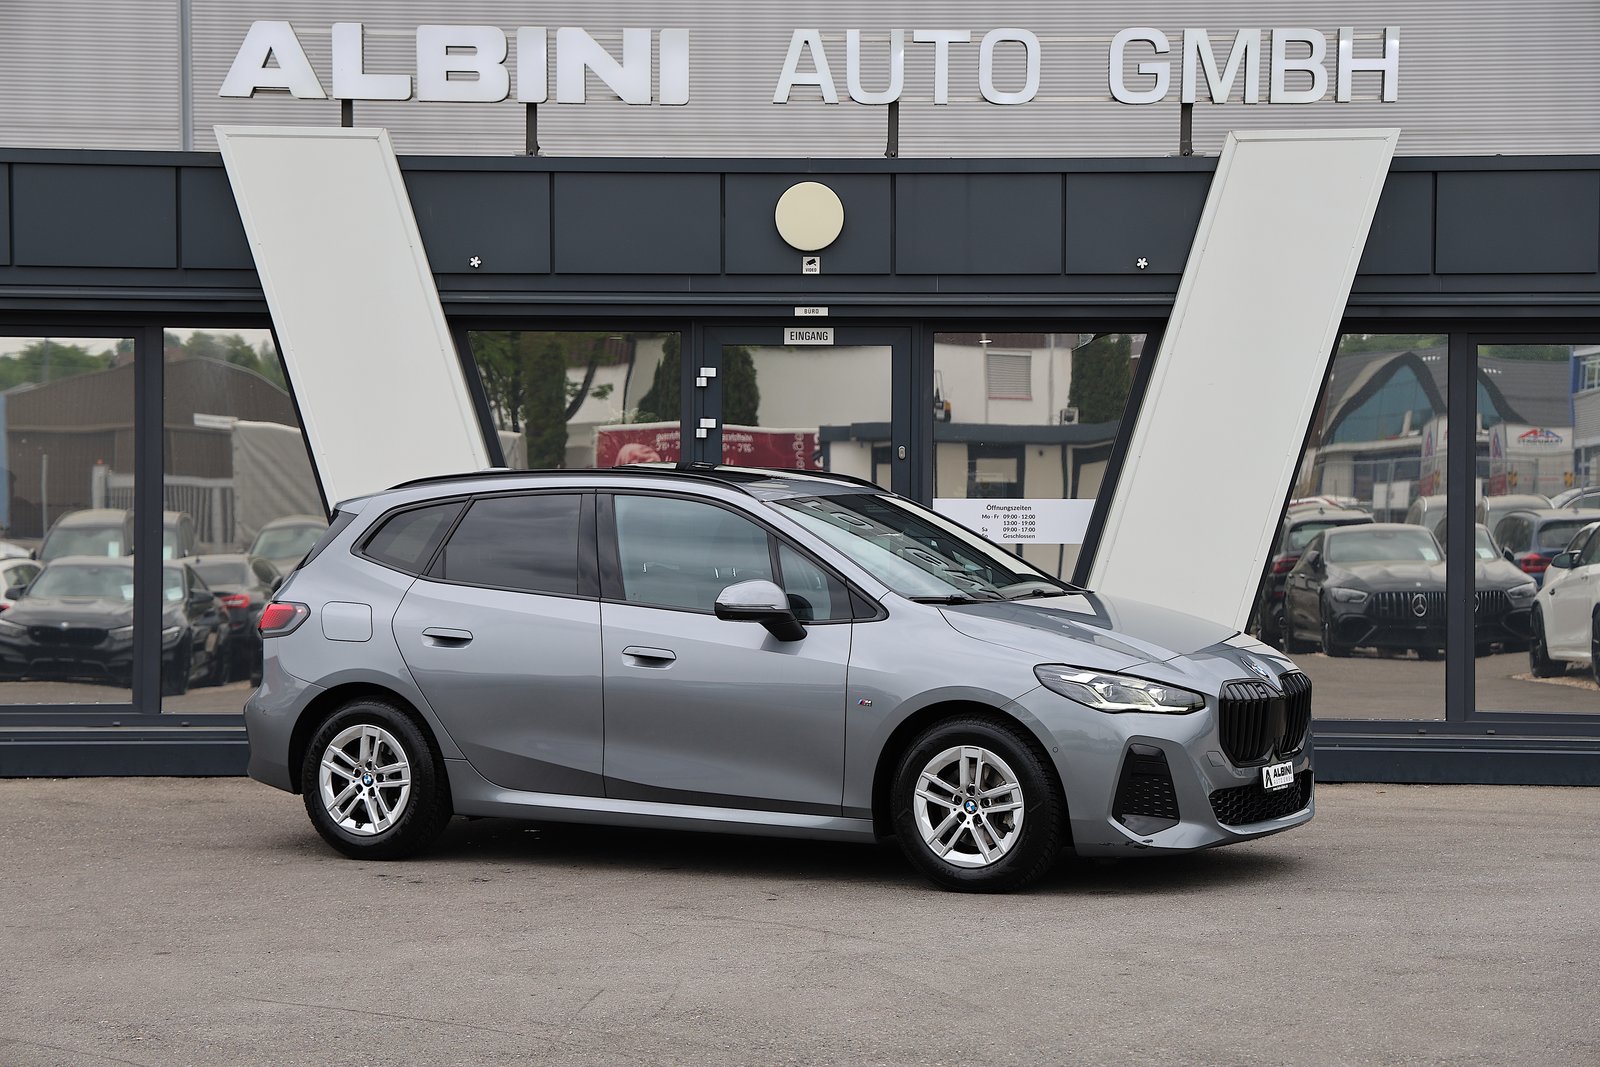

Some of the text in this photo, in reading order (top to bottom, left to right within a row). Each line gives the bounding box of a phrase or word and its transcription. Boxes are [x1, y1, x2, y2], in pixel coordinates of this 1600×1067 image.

[219, 20, 1401, 106] ALBINI AUTO GMBH
[790, 331, 829, 341] EINGANG
[986, 504, 1032, 512] Öffnungszeiten
[1273, 765, 1292, 778] ALBINI
